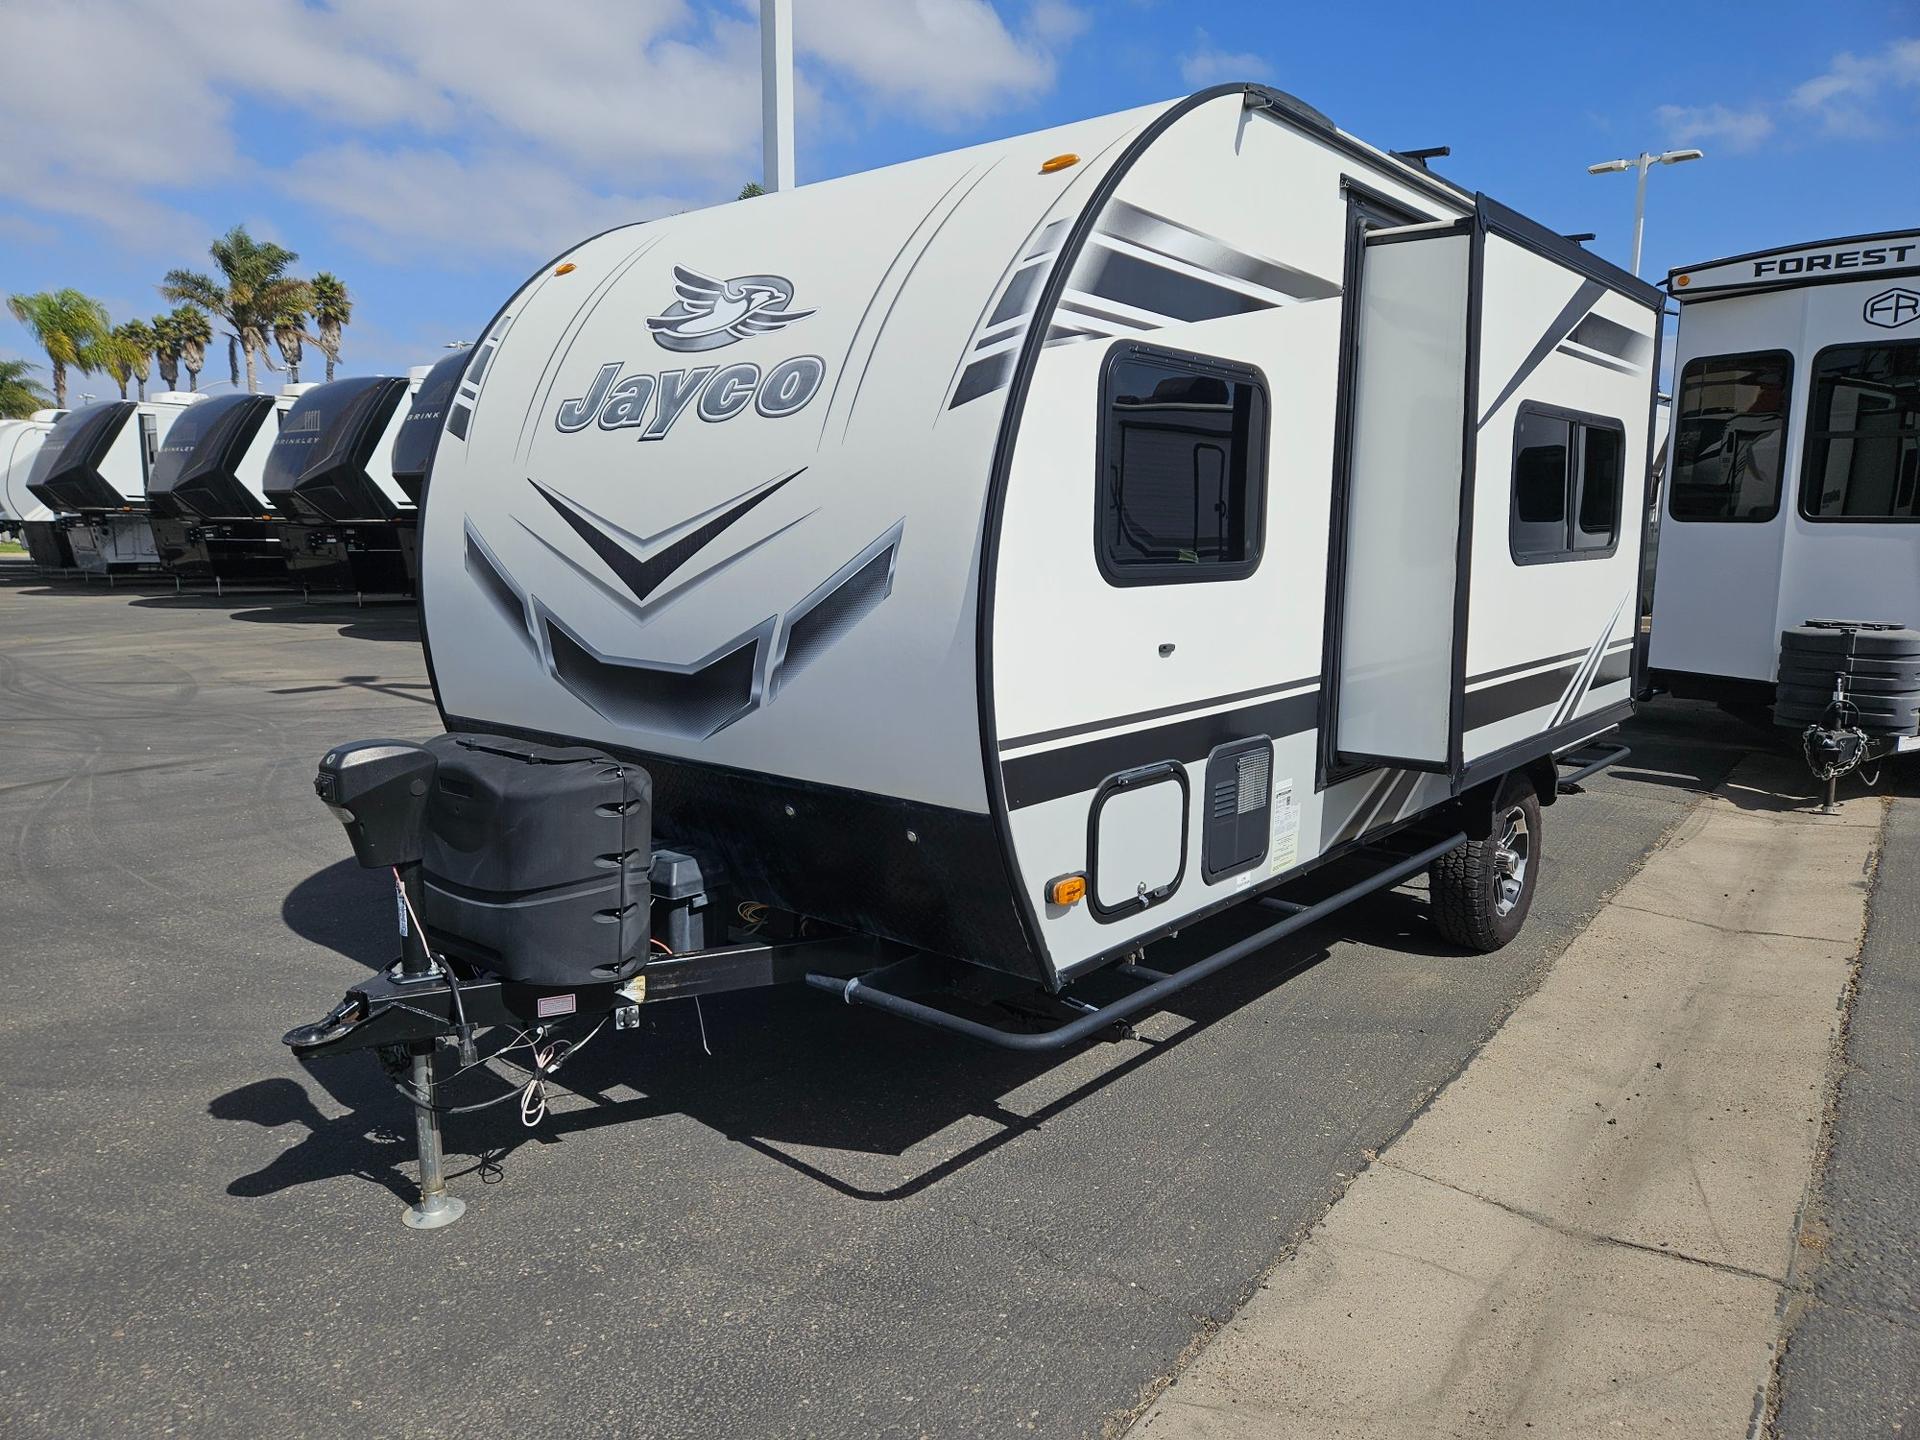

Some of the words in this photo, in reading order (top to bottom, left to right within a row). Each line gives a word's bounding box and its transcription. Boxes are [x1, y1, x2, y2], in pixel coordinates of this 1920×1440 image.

[1754, 244, 1917, 278] FOREST
[555, 354, 827, 442] Jayco
[406, 412, 440, 421] BRINK
